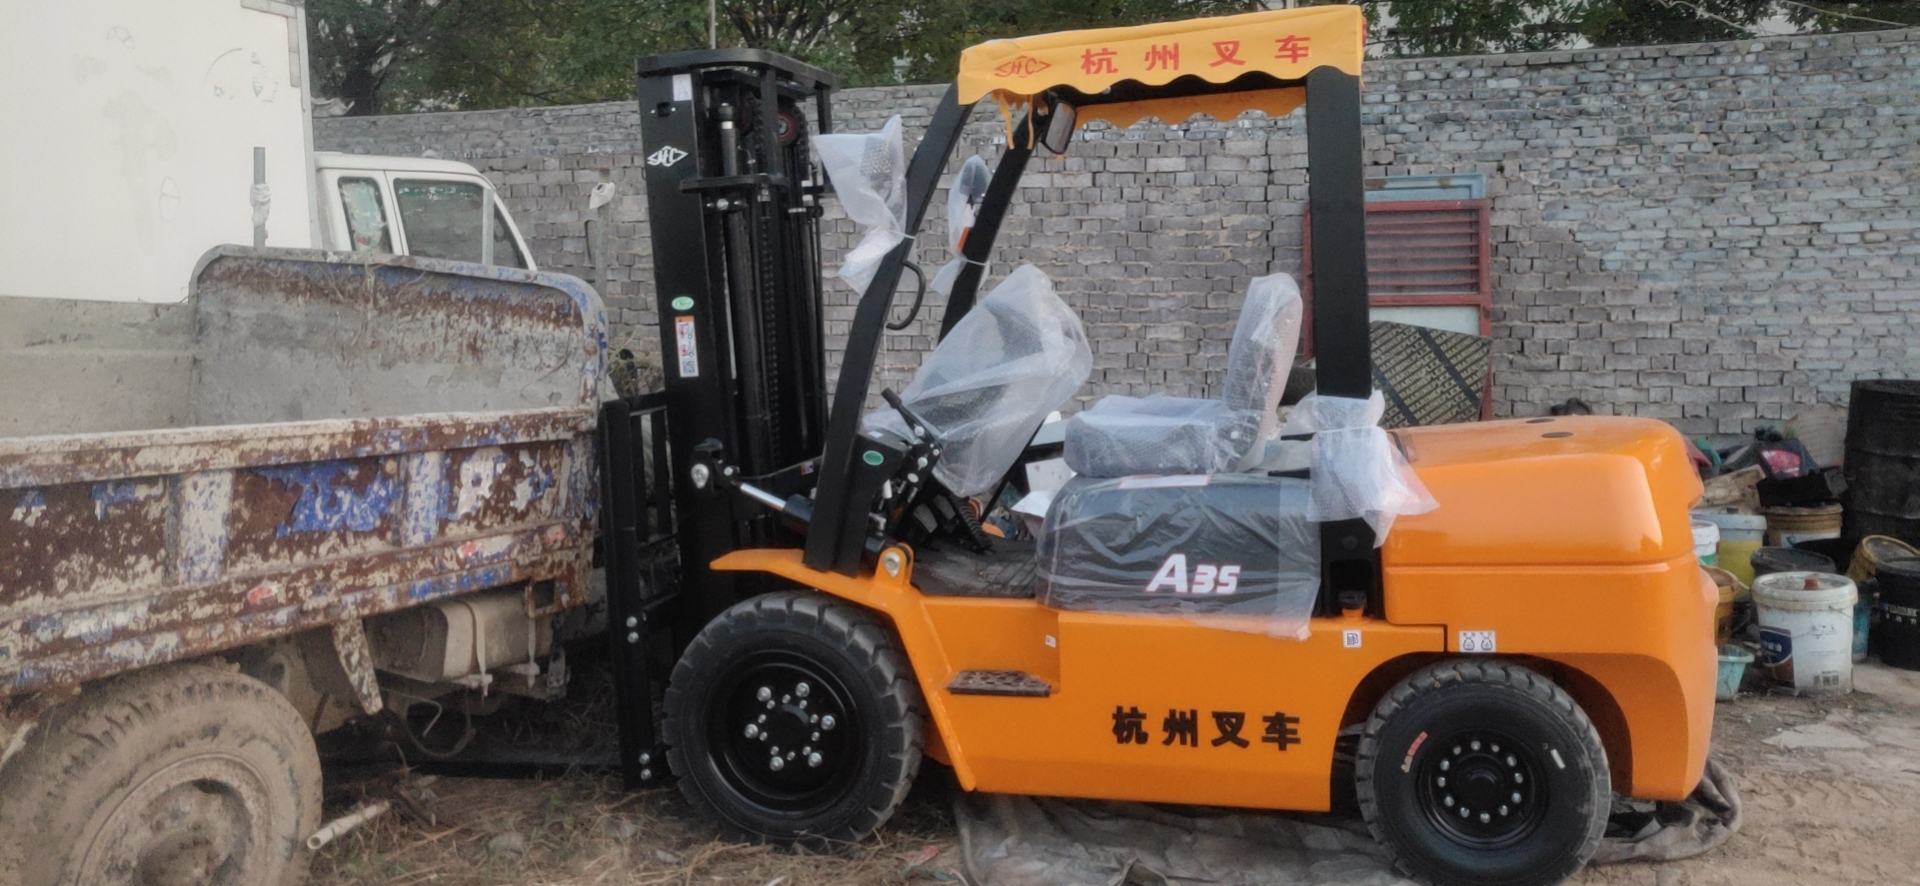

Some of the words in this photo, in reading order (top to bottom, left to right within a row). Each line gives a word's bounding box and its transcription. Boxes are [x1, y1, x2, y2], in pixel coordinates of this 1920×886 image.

[1079, 35, 1311, 76] 杭州叉车
[1112, 705, 1301, 751] 杭州叉车
